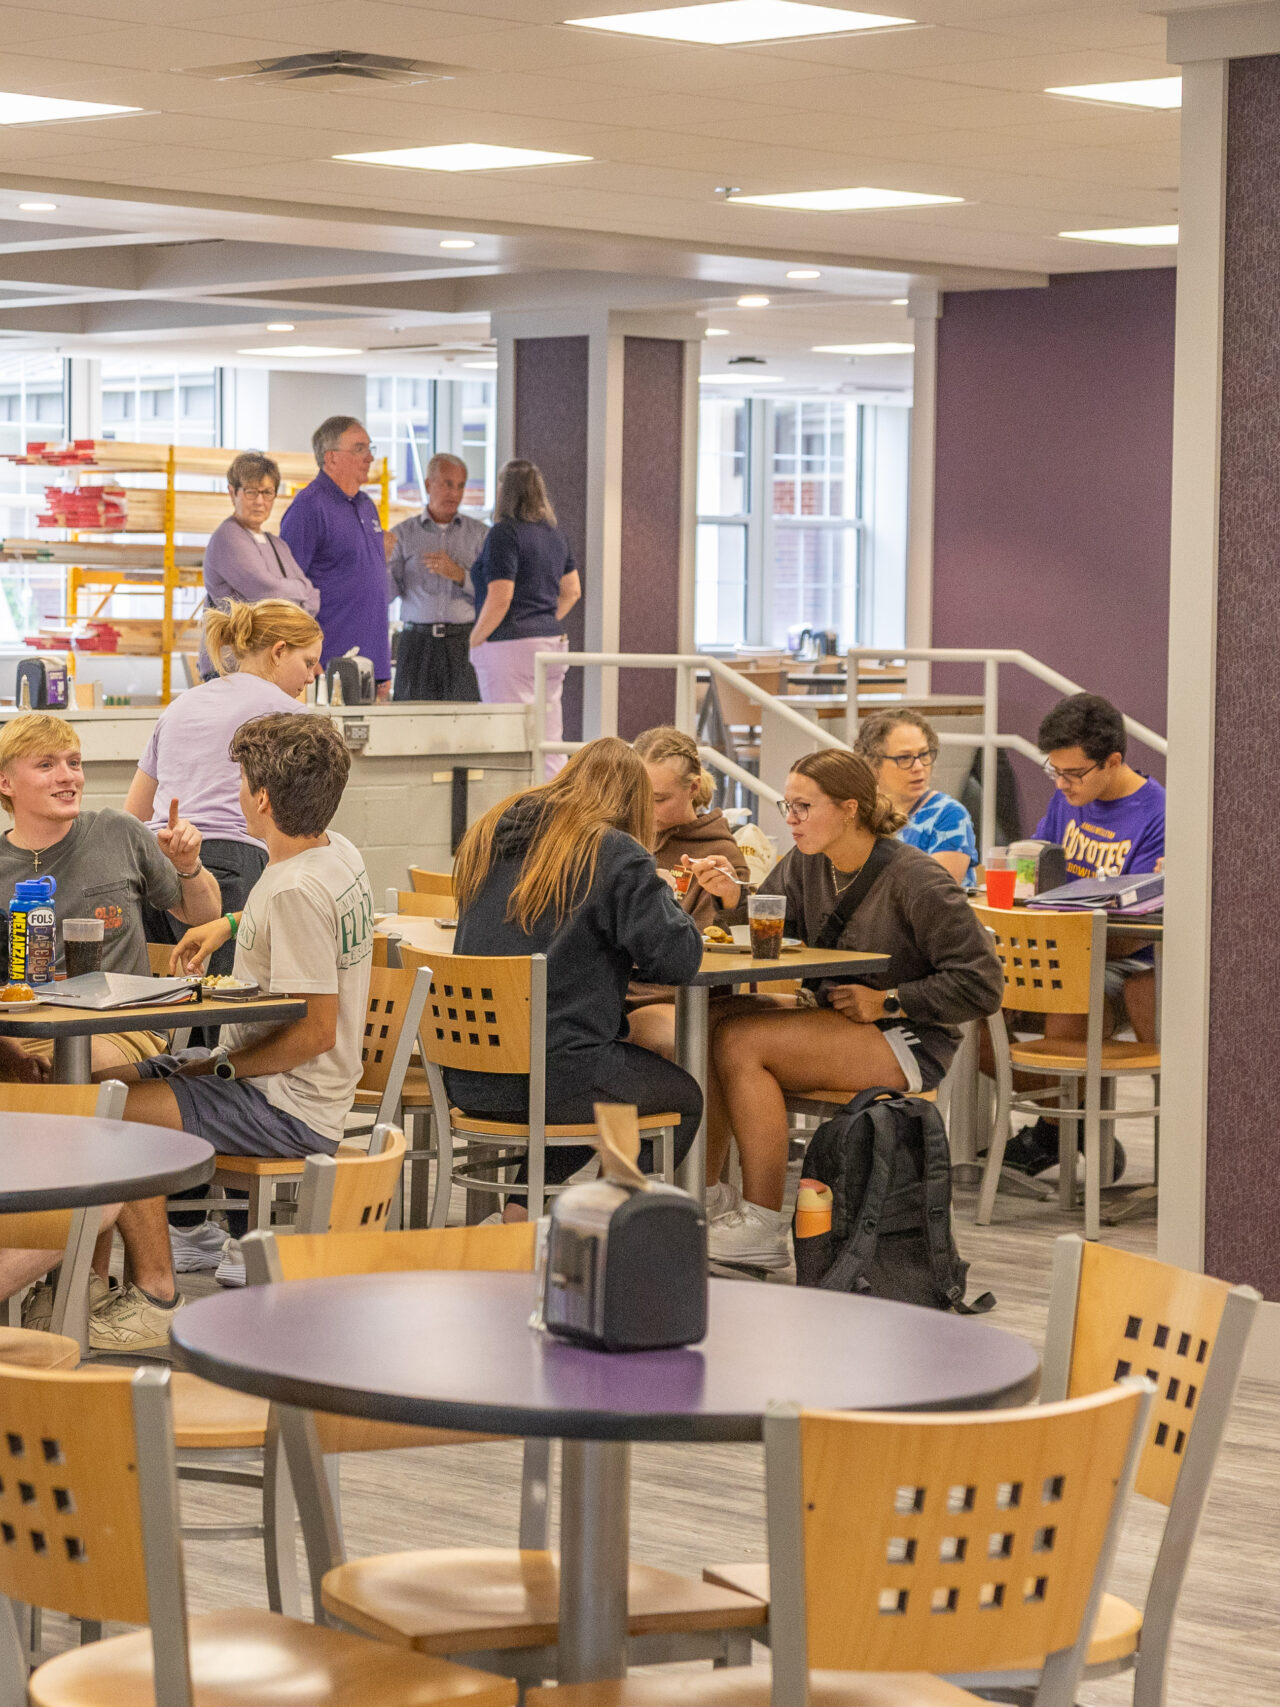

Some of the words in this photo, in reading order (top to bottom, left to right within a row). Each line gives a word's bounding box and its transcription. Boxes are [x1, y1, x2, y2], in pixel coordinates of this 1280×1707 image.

[1062, 819, 1131, 878] COYOTES
[31, 913, 53, 924] FOLS
[94, 905, 117, 919] OLD
[11, 911, 27, 980] MELANZANA
